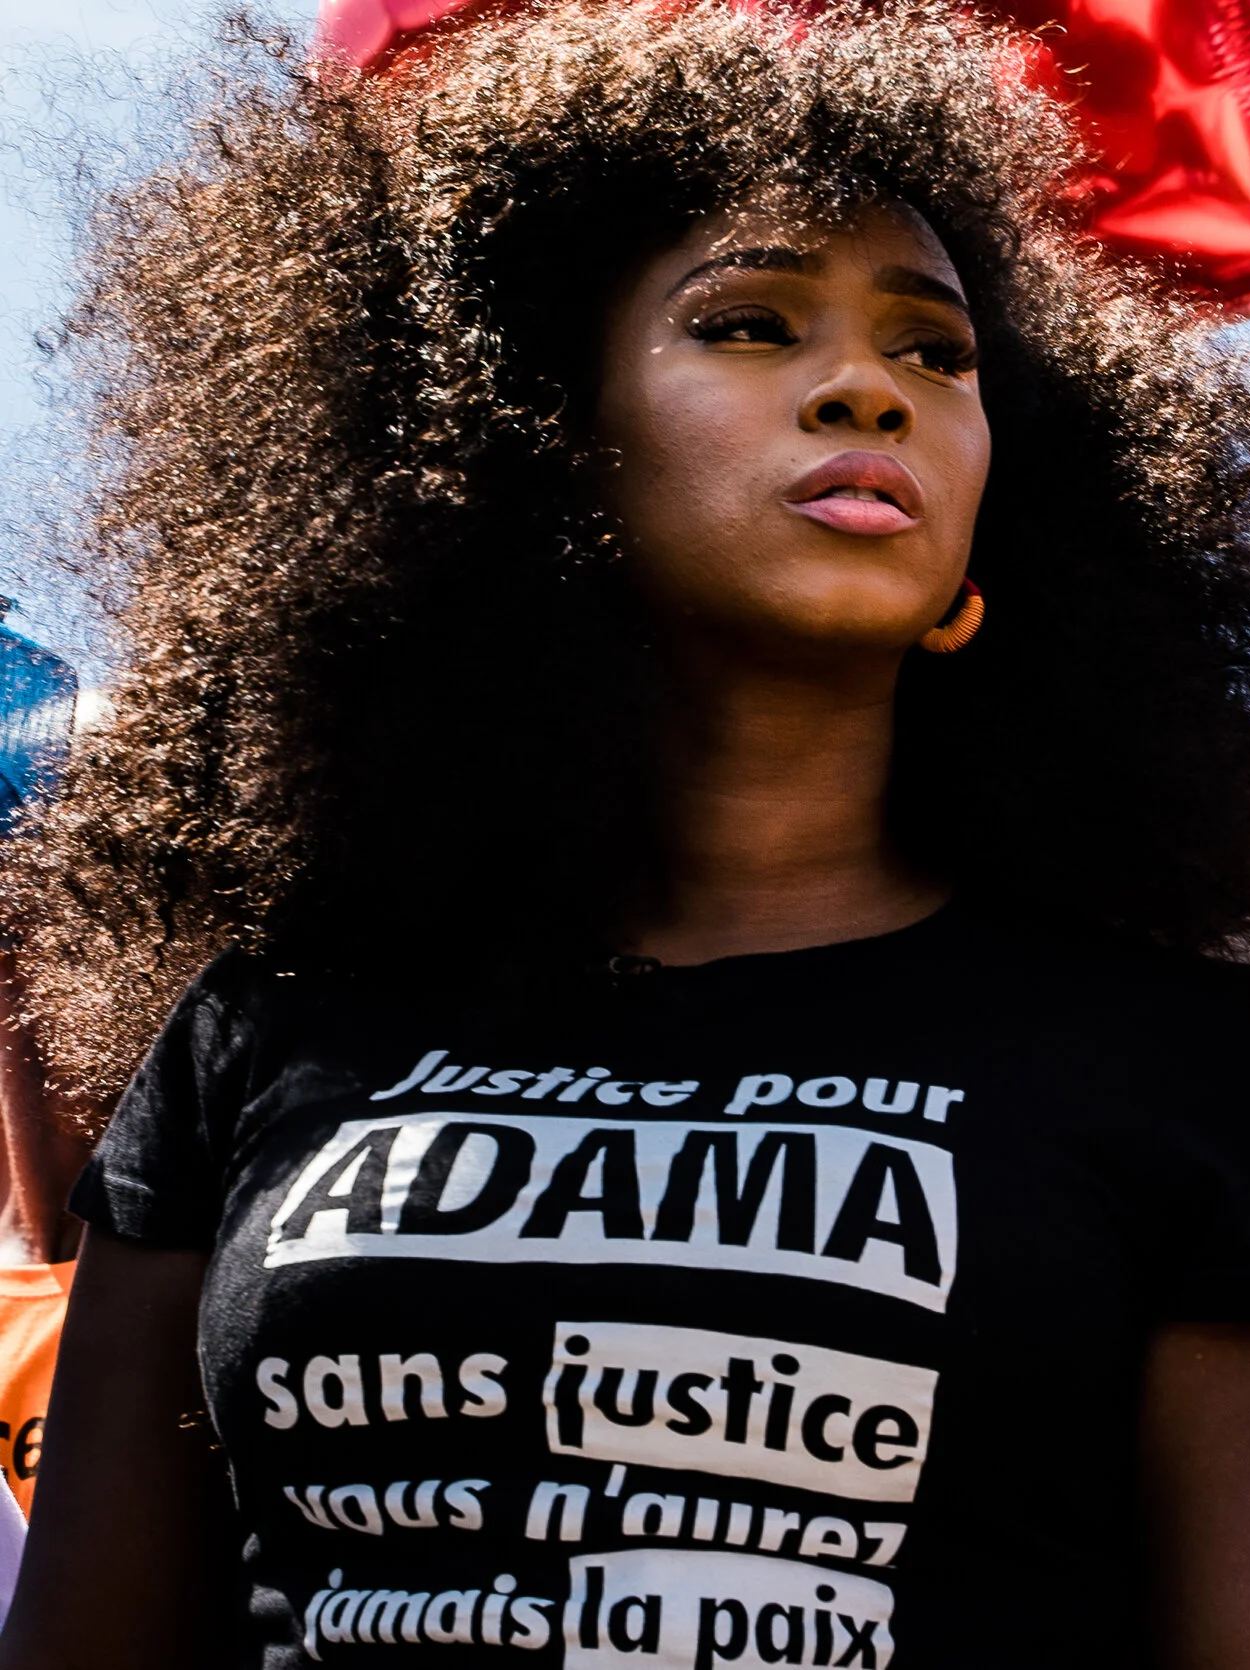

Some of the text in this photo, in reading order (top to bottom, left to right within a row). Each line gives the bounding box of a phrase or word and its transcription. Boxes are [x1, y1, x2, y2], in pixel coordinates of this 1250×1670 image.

[370, 1050, 965, 1122] Justice pour
[278, 1119, 944, 1288] ADAMA
[255, 1334, 920, 1470] sans justice
[284, 1479, 492, 1536] vous
[303, 1566, 881, 1670] jamais la paix
